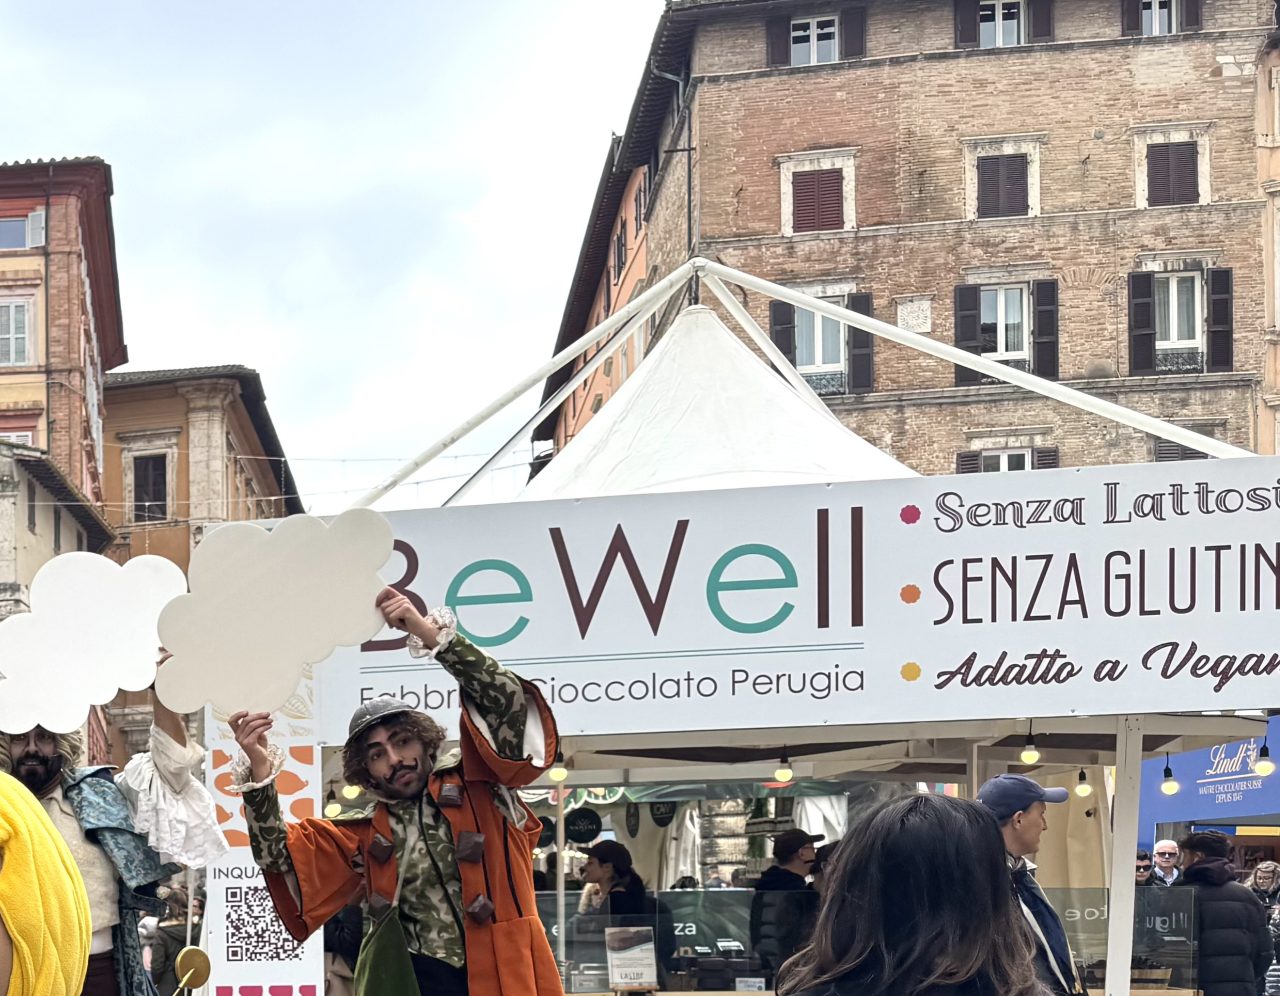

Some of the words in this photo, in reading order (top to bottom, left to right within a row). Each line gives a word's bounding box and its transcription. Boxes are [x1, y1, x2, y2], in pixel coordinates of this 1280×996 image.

[933, 491, 1086, 533] Senza
[933, 552, 1089, 626] SENZA
[1103, 542, 1280, 618] GLUTIN
[731, 664, 865, 700] Perugia
[933, 648, 1083, 690] Adatto
[1093, 660, 1128, 682] a
[1205, 743, 1248, 776] Lindt
